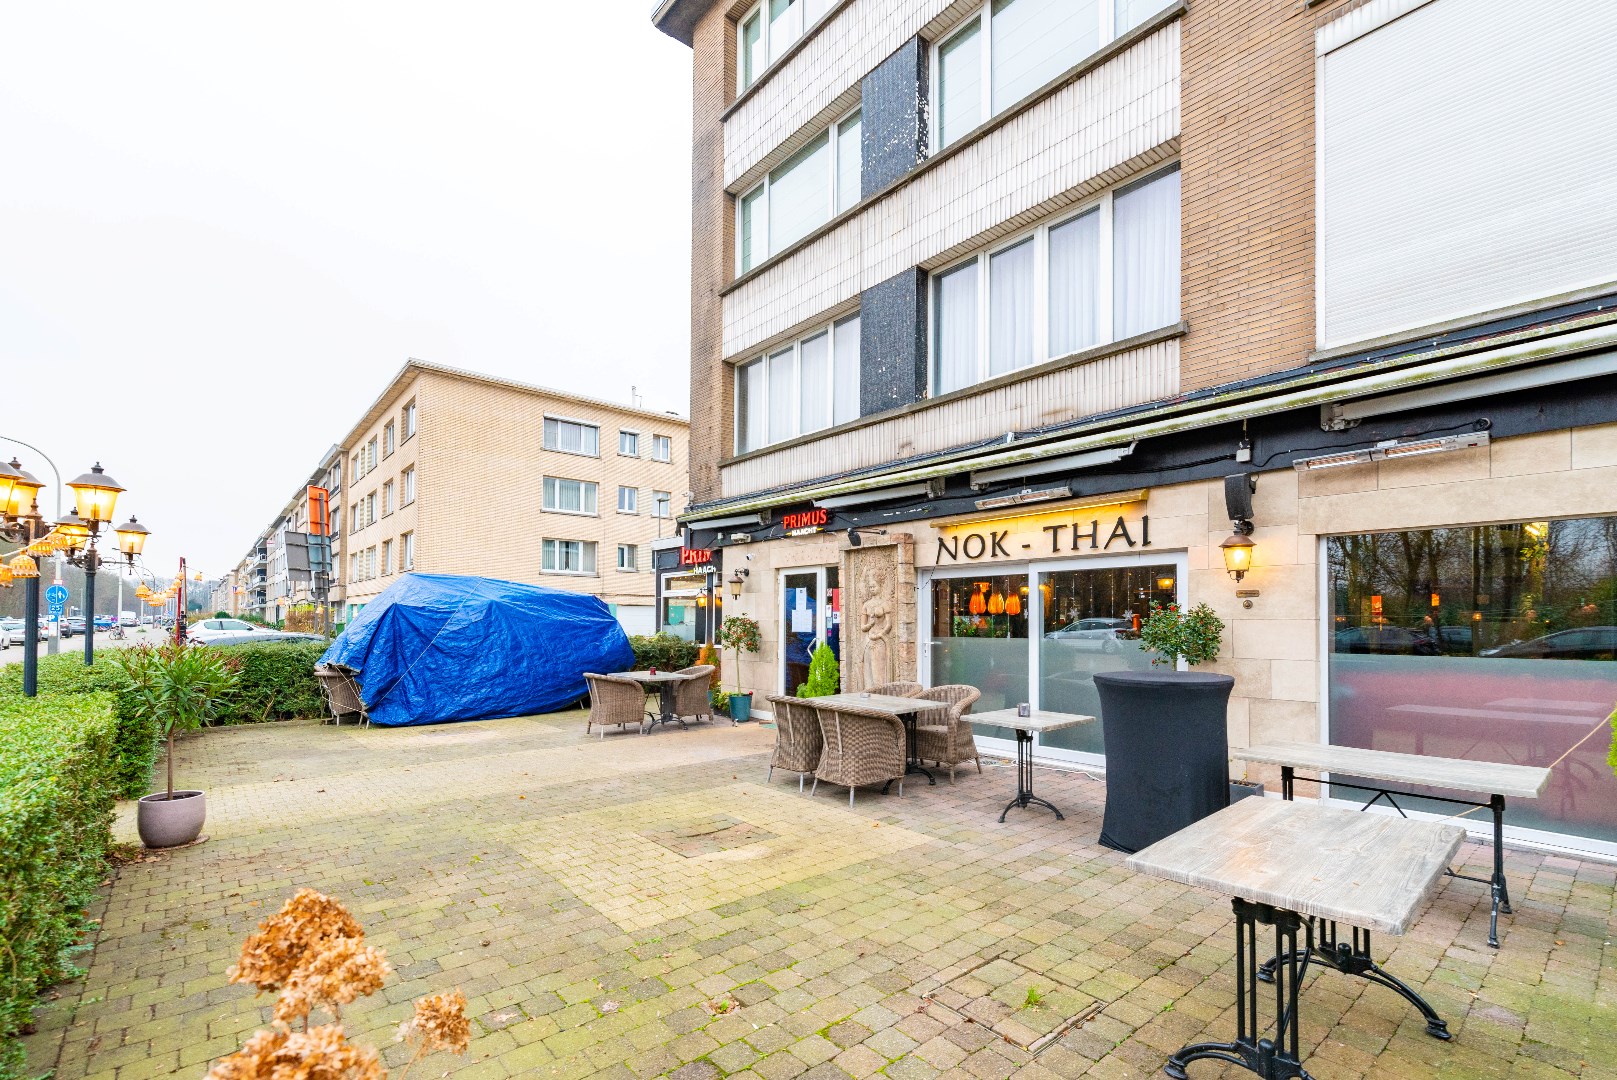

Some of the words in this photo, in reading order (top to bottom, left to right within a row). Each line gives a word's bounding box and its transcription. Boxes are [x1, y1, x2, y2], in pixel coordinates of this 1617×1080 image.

[783, 509, 827, 530] PRIMUS
[937, 531, 1010, 564] NOK
[1042, 514, 1151, 553] THAI
